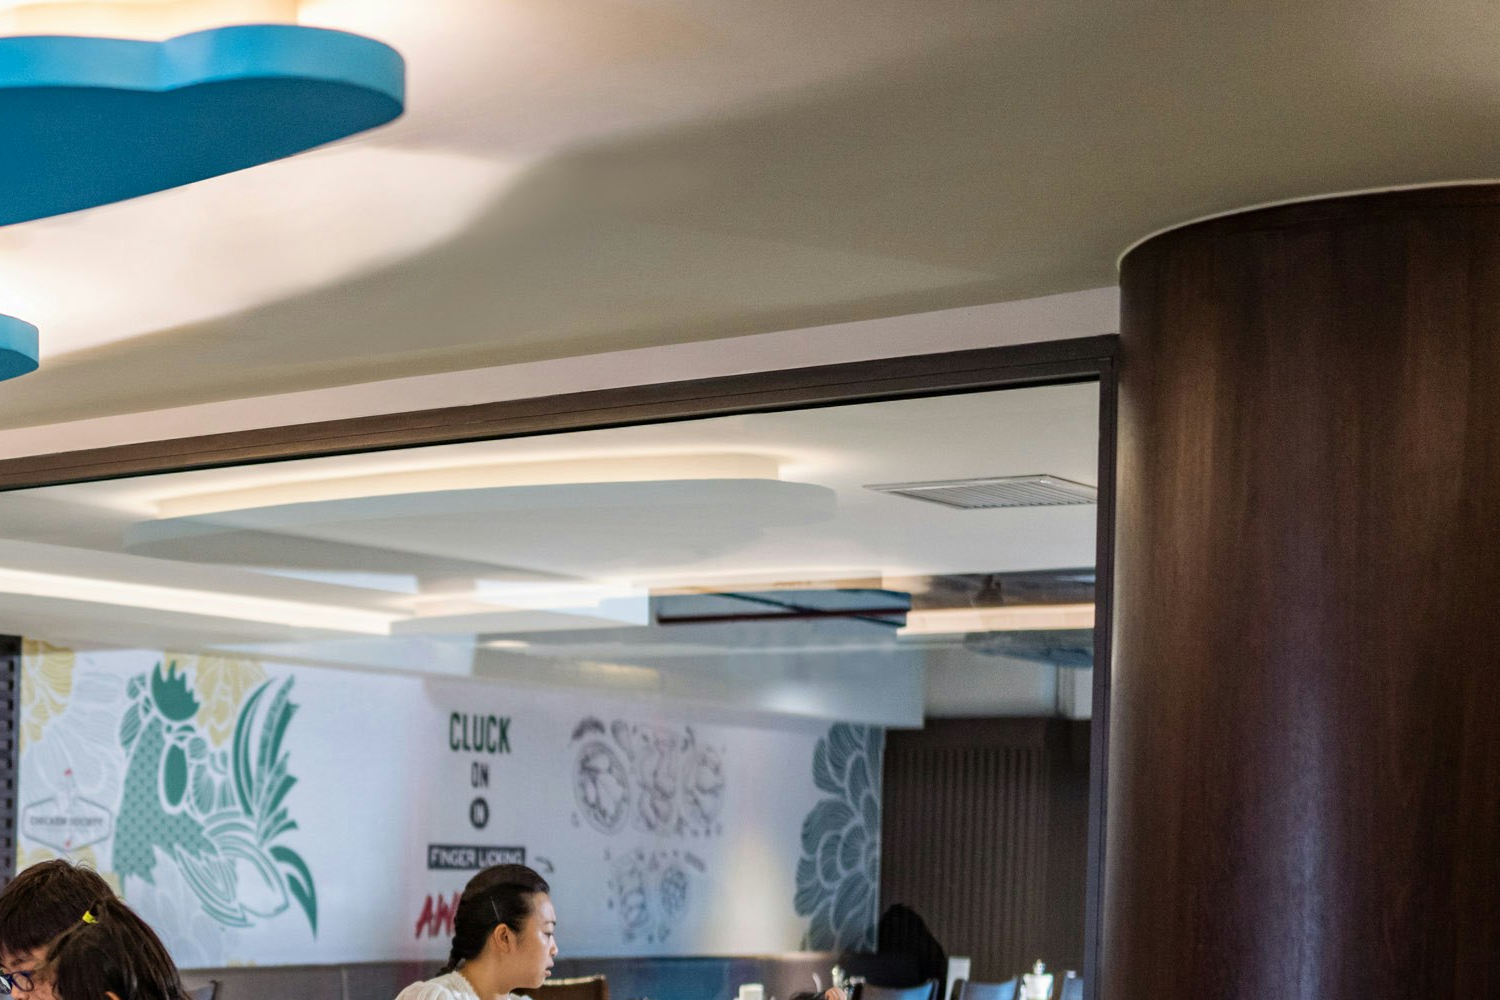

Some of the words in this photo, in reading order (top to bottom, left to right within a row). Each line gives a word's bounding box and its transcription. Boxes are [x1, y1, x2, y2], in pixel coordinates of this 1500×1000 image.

[450, 712, 511, 753] CLUCK
[471, 761, 489, 788] ON
[431, 847, 475, 867] FINGER
